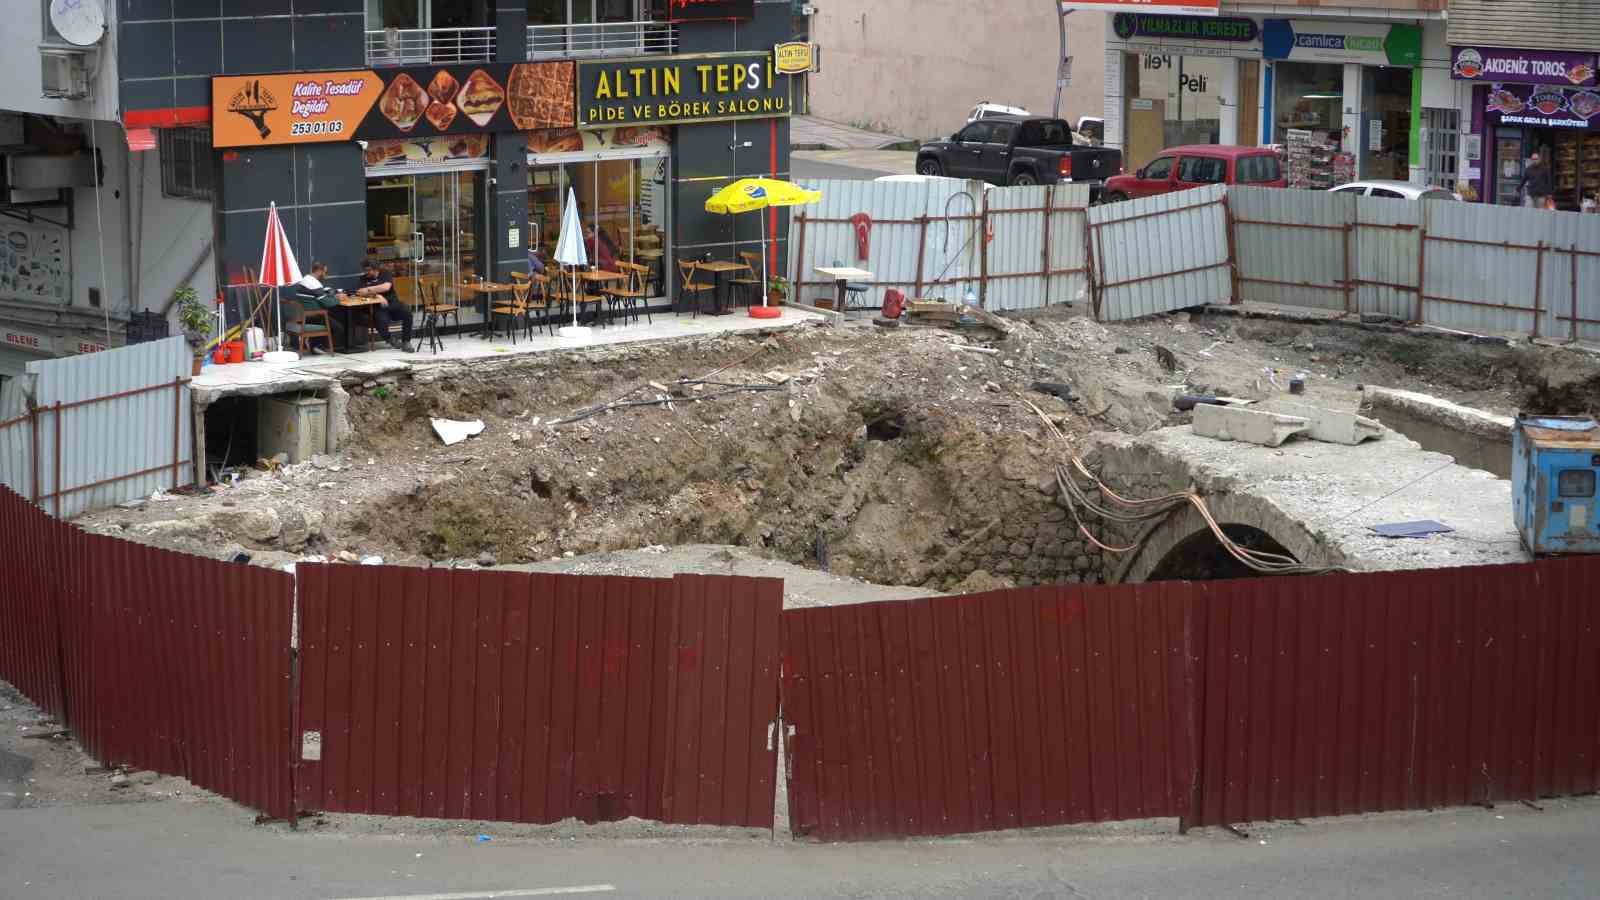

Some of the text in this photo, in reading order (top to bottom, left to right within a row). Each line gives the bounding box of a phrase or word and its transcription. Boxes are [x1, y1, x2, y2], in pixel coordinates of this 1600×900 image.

[1140, 17, 1249, 37] YILMAZLAR KERESTE
[1484, 56, 1528, 74] AKDENİZ
[1532, 60, 1566, 76] TOROS
[596, 55, 773, 99] ALTIN TEPSİ
[1179, 73, 1207, 93] Peli
[293, 80, 363, 97] Kalite Tesadüf
[292, 98, 329, 117] Değildir
[589, 97, 784, 121] PİDE VE BÖREK SALONU
[291, 120, 343, 135] 253 01 03
